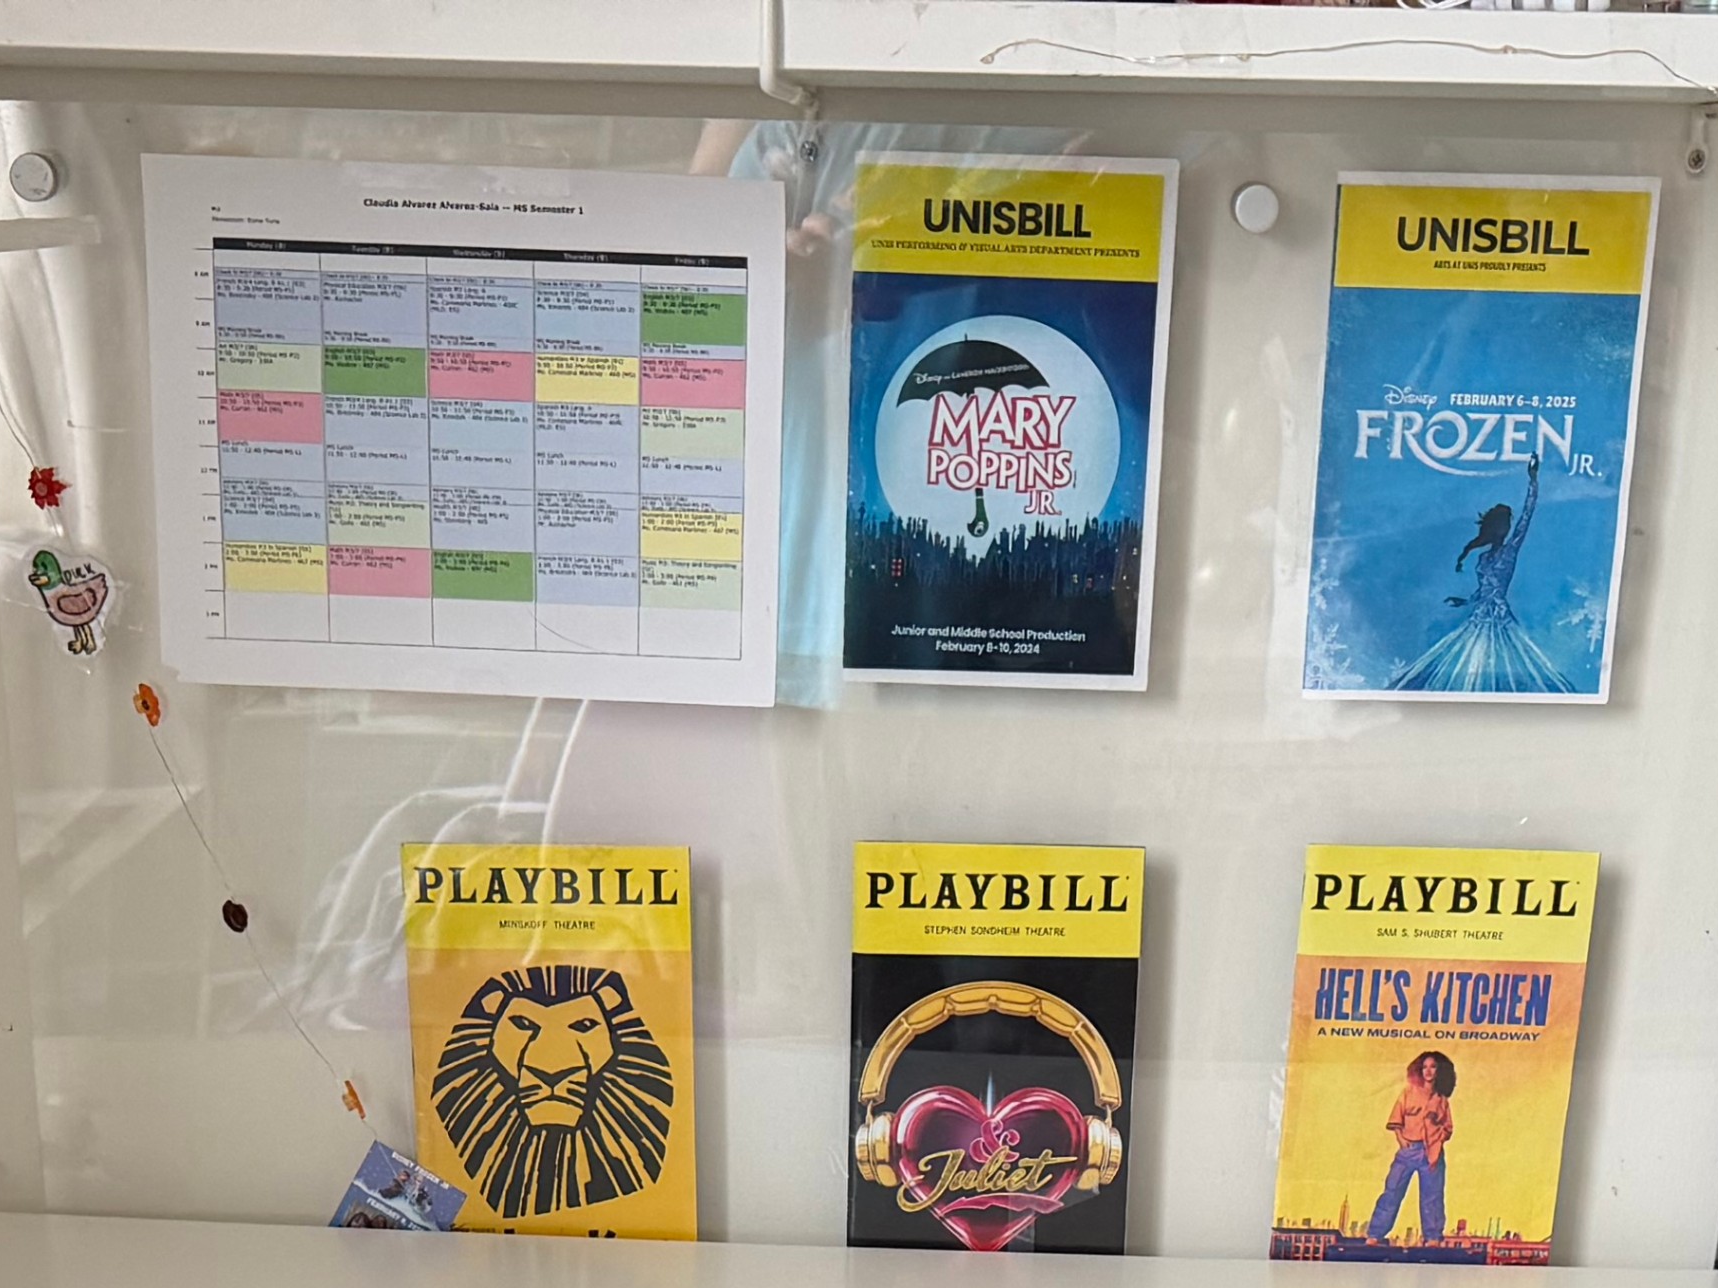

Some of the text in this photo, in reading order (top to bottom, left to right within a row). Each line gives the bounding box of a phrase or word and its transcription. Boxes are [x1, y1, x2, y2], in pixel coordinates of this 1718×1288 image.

[362, 198, 399, 209] Claudia
[401, 199, 437, 210] Alvarez
[529, 205, 576, 215] Semester
[924, 199, 1092, 238] UNISBILL
[895, 241, 957, 252] PERFORMING
[969, 243, 1002, 253] VISUAL
[1004, 244, 1027, 254] ARTS
[1029, 246, 1092, 256] DEPARTMENT
[1093, 247, 1140, 257] PRESENTS
[1397, 216, 1590, 256] UNISBILL
[1433, 260, 1451, 270] ARTS
[1452, 261, 1462, 270] AT
[1480, 262, 1511, 271] PROUDLY
[1512, 262, 1547, 272] PRESENTS
[1383, 384, 1438, 410] Disney
[1450, 393, 1515, 407] FEBRUARY
[1546, 396, 1577, 408] 2025
[928, 391, 1077, 455] MARY
[1354, 409, 1575, 476] FROZEN
[927, 448, 1073, 493] POPPINS
[891, 624, 1085, 641] Junior and Middle School Production
[935, 641, 984, 655] February
[1014, 643, 1040, 655] 2024
[414, 866, 678, 905] PLAYBILL
[865, 872, 1128, 912] PLAYBILL
[1310, 873, 1579, 917] PLAYBILL
[499, 919, 595, 930] MINSKOFF THEATRE
[924, 924, 1066, 937] STEPHEN SONDHEIM THEATRE
[1376, 927, 1398, 938] SAM
[1413, 928, 1458, 940] SHUBERT
[1462, 929, 1504, 941] THEATRE
[1420, 970, 1552, 1027] KITCHEN
[1317, 1027, 1541, 1042] A NEW MUSICAL ON BROADWAY
[896, 1145, 1079, 1213] Juliet
